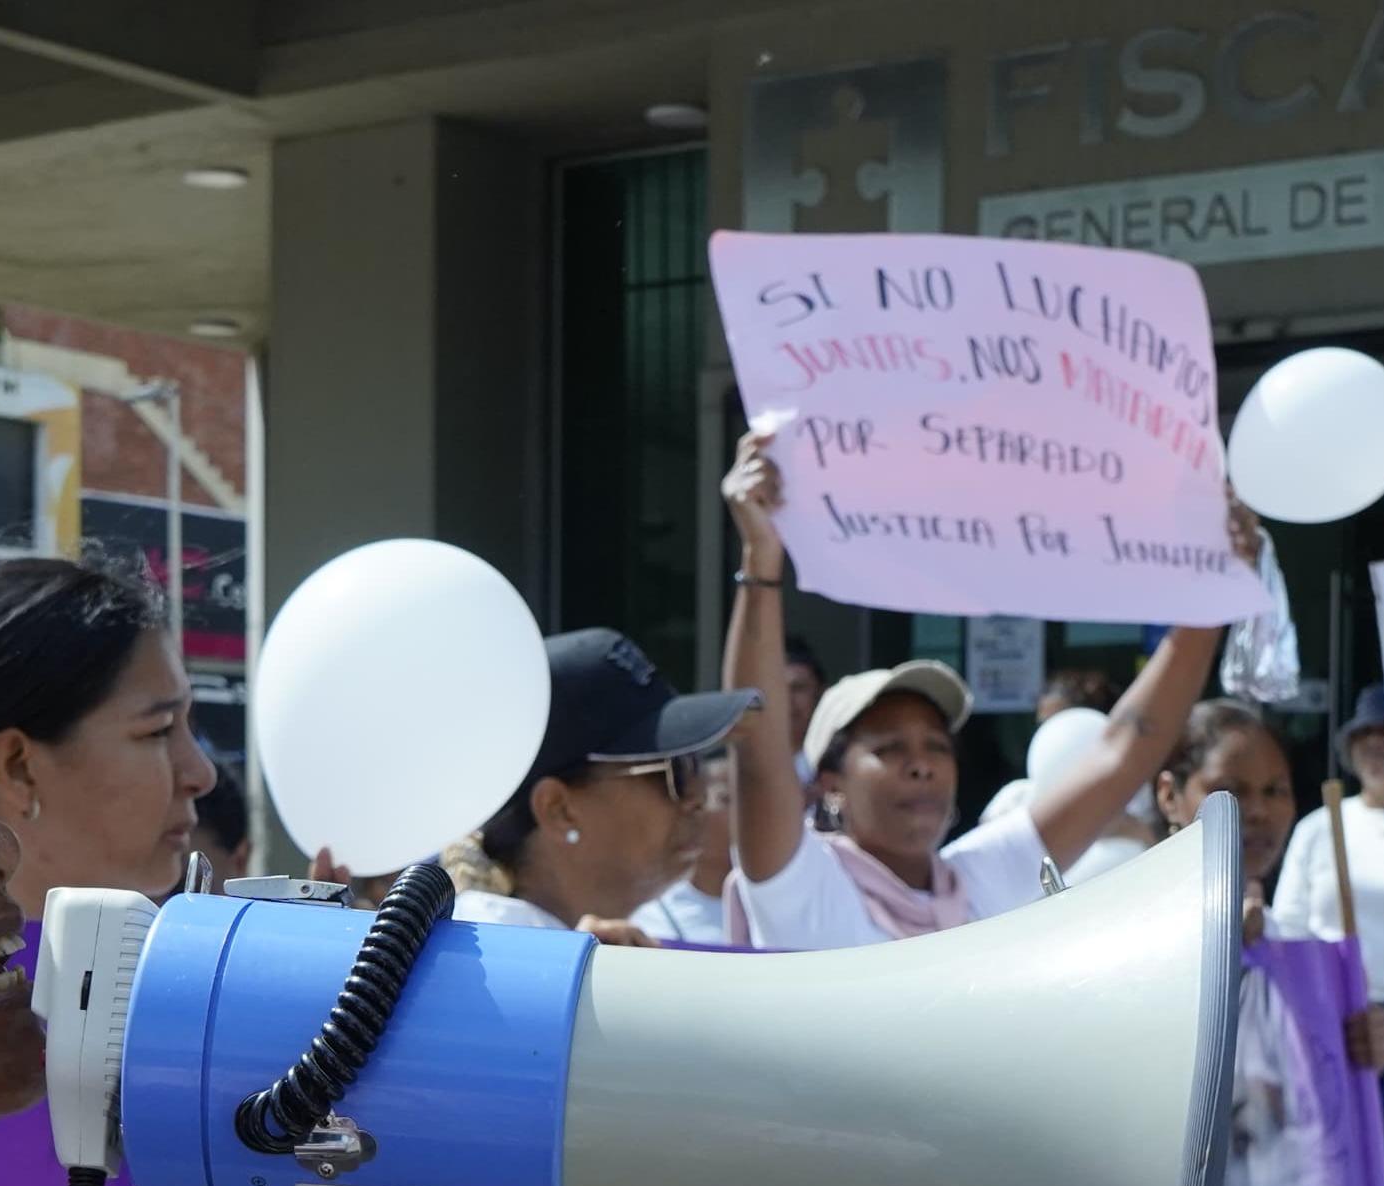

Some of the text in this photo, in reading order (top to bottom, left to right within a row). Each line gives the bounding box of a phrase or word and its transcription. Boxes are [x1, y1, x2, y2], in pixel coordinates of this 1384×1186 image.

[1002, 189, 1269, 249] GENERAL
[1290, 175, 1367, 232] DE
[759, 260, 1211, 428] SI NO LUCHAMOS
[794, 415, 889, 470] POR
